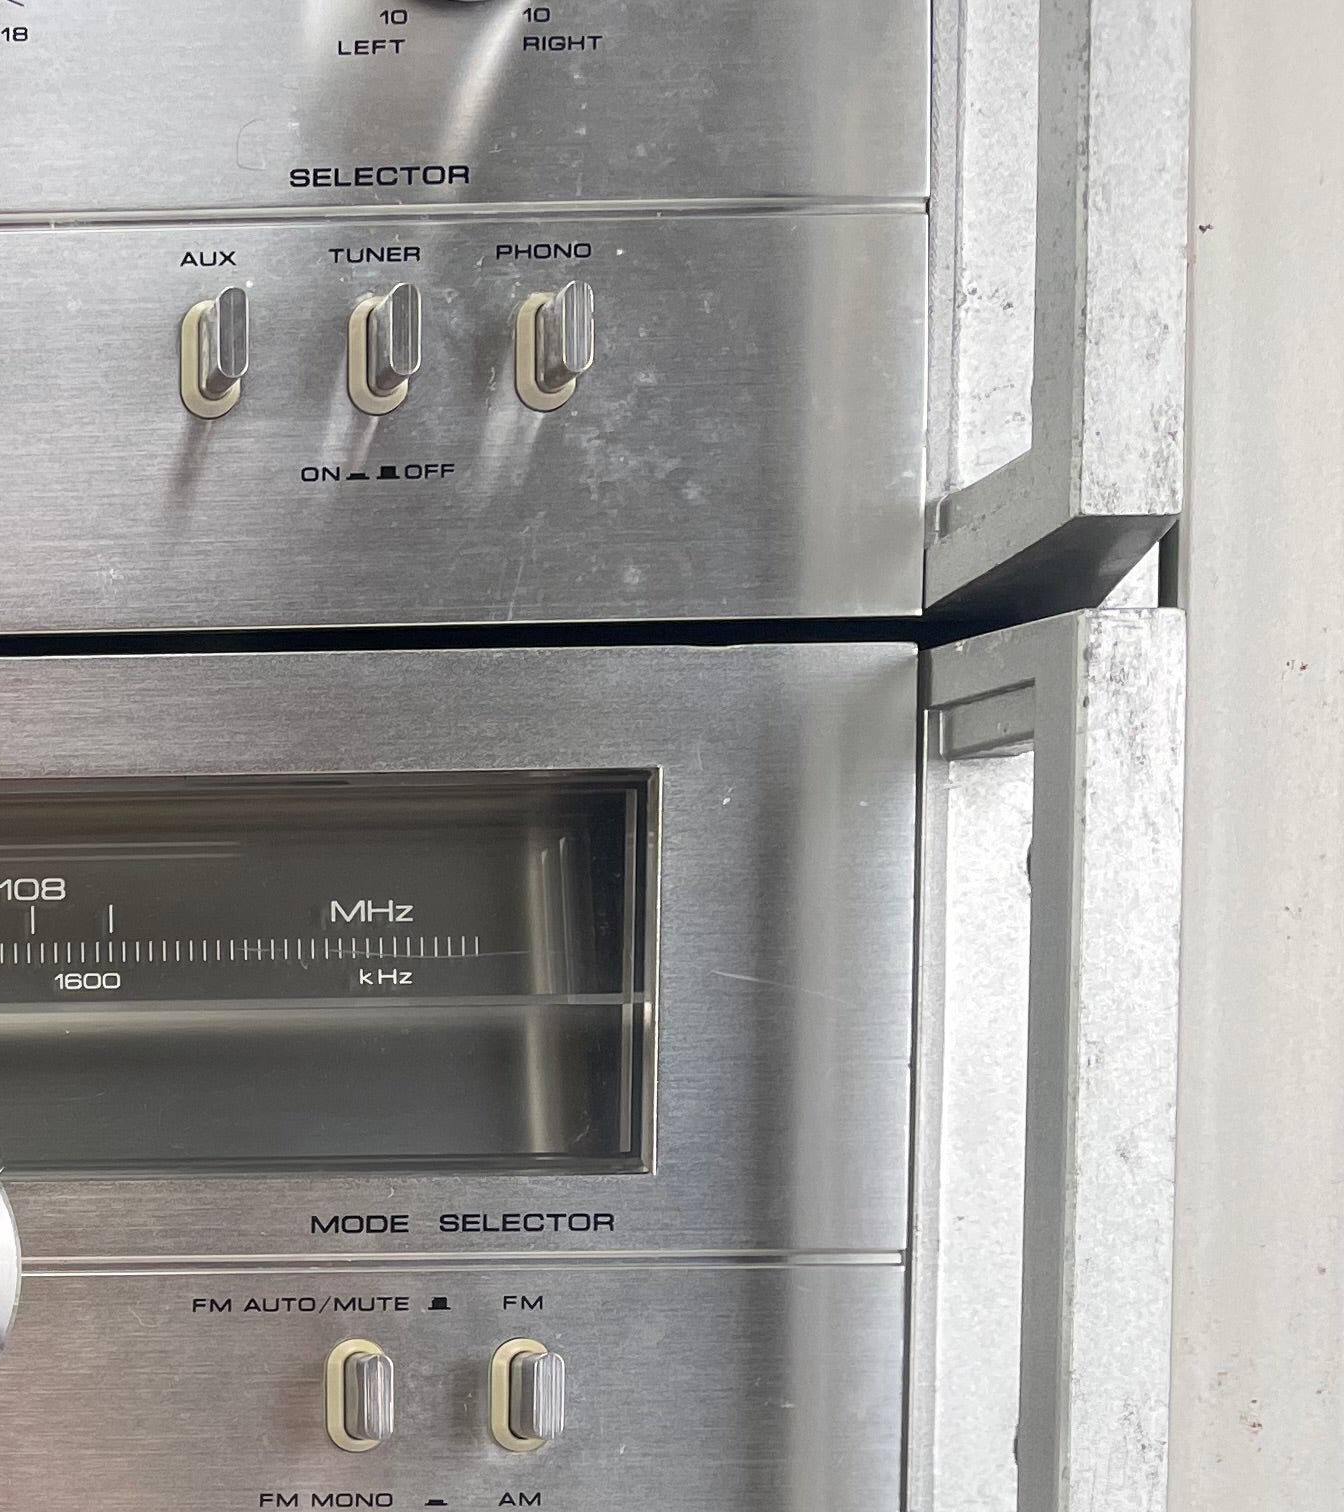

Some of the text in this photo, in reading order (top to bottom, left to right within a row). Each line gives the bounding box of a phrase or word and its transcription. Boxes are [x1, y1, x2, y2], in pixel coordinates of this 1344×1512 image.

[379, 8, 408, 25] 10
[522, 7, 551, 23] 10
[0, 26, 29, 42] 18
[338, 38, 406, 56] LEFT
[522, 35, 603, 52] RIGHT
[289, 165, 470, 188] SELECTOR
[179, 250, 237, 267] AUX
[328, 246, 421, 264] TUNER
[495, 242, 592, 261] PHONO
[300, 466, 341, 482] ON
[404, 463, 455, 480] OFF
[330, 899, 414, 923] MHz
[54, 972, 121, 990] 1600
[359, 968, 413, 985] kHz
[310, 1212, 615, 1234] MODE SELECTOR
[192, 1295, 410, 1314] FM AUTO/MUTE
[503, 1295, 544, 1311] FM
[259, 1492, 394, 1508] FM MONO
[498, 1491, 542, 1507] AM
